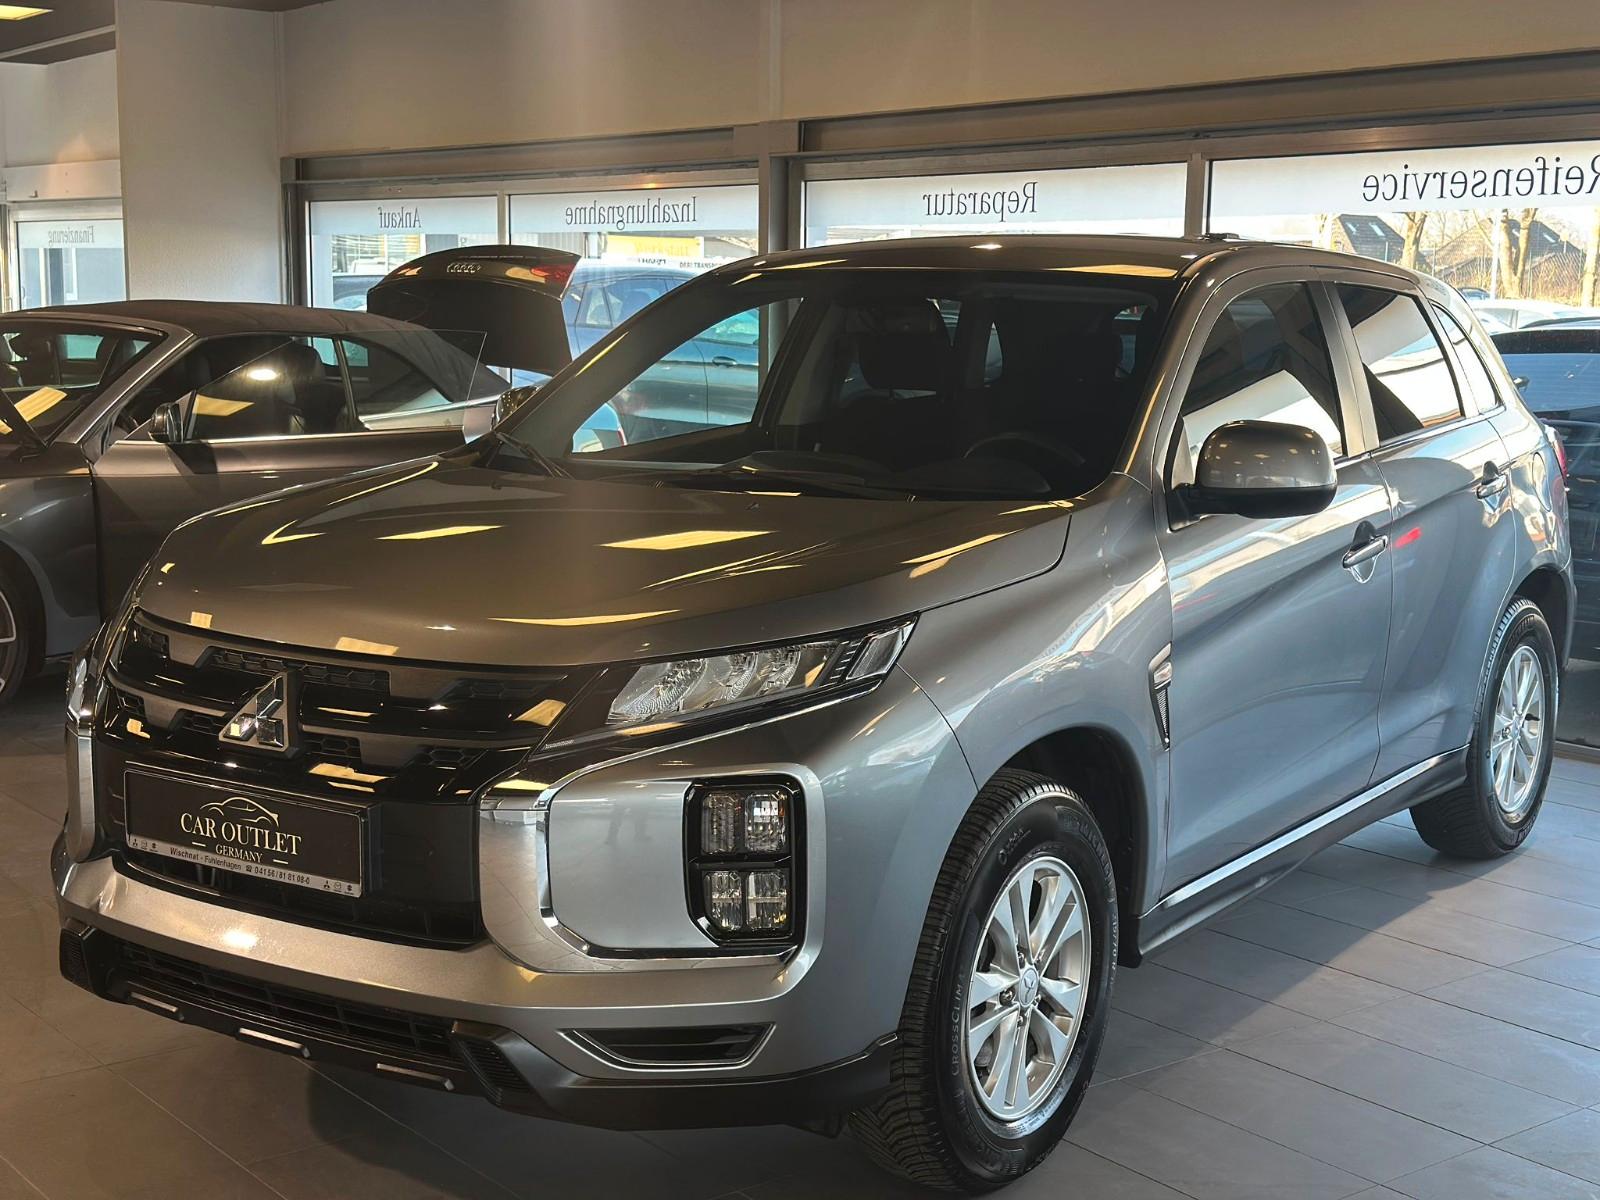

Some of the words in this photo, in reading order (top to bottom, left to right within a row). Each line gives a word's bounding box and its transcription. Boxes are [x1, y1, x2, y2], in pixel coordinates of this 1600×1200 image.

[180, 812, 217, 839] CAR
[221, 821, 302, 855] OUTLET
[215, 844, 263, 864] GERMANY
